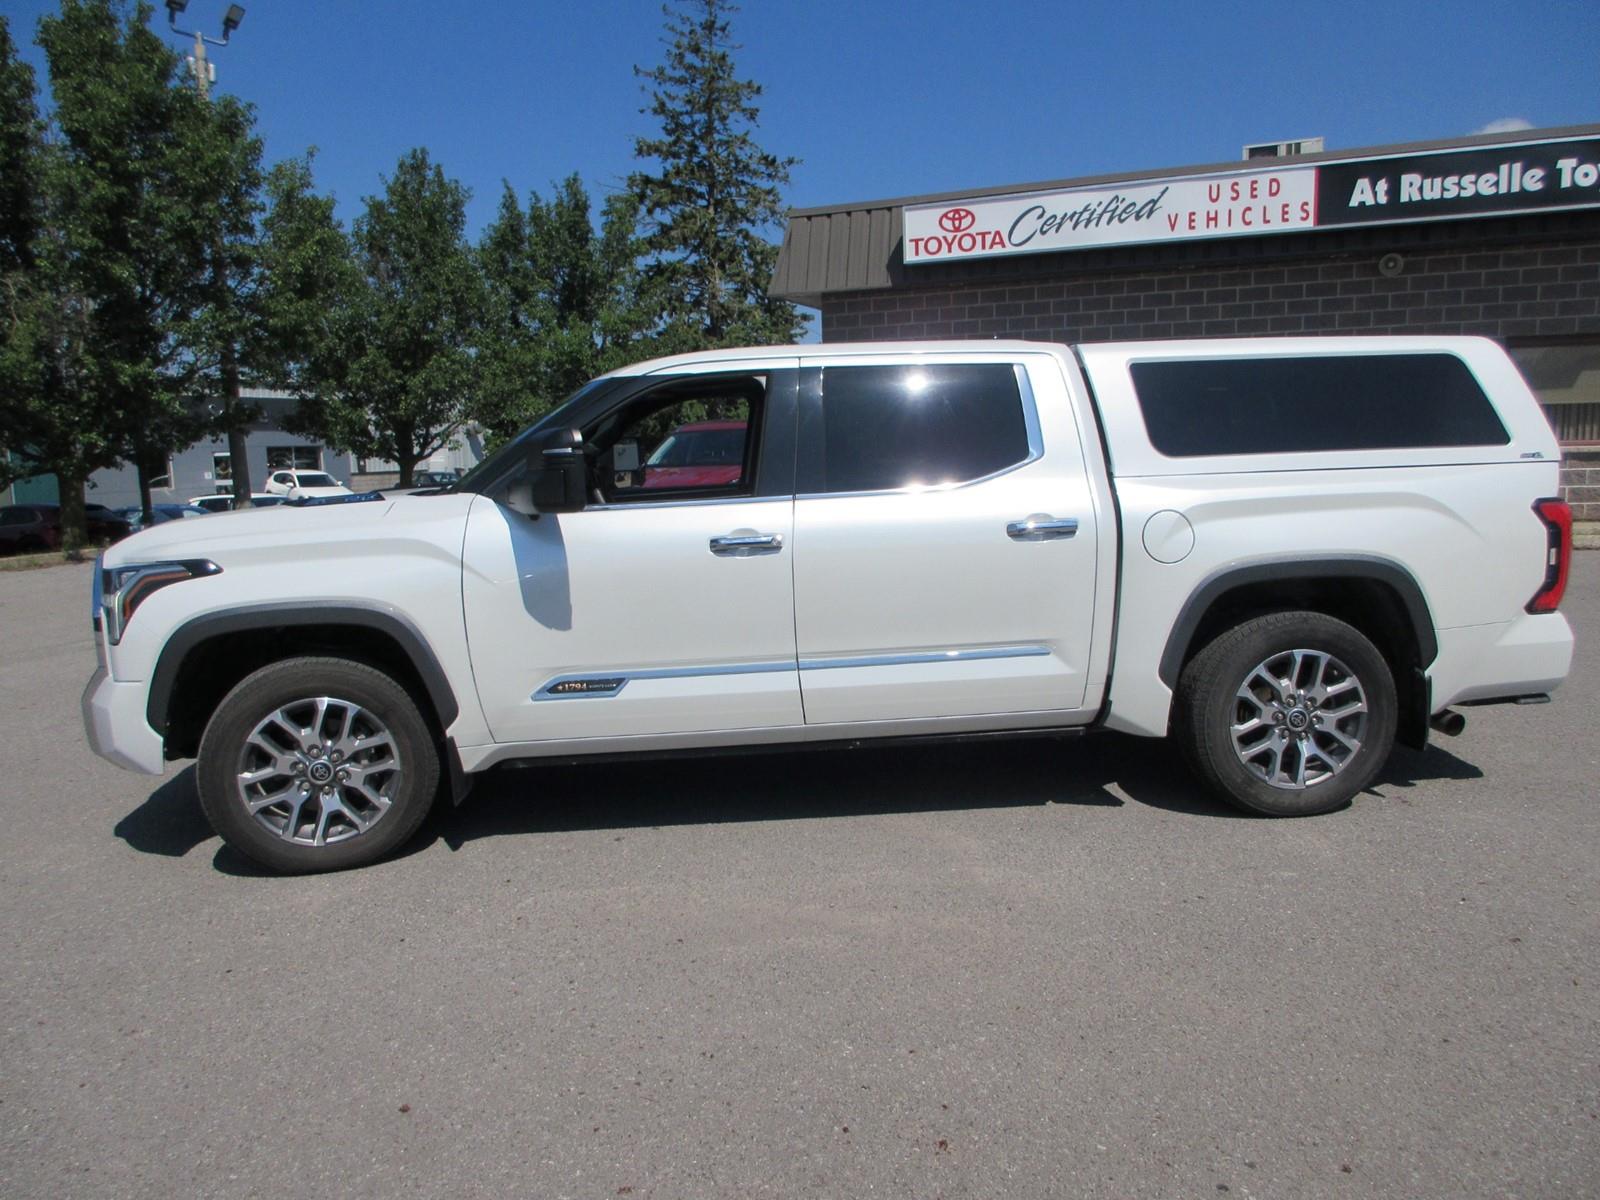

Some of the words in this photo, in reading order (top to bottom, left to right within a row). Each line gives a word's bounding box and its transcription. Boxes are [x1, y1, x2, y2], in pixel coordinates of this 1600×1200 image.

[1208, 177, 1281, 204] USED
[1348, 176, 1390, 207] At
[1400, 162, 1546, 203] Russelle
[1555, 158, 1600, 192] To
[908, 230, 1006, 257] TOYOTA
[1007, 186, 1170, 248] Certified
[1167, 201, 1311, 233] VEHICLES
[564, 682, 587, 692] 1794
